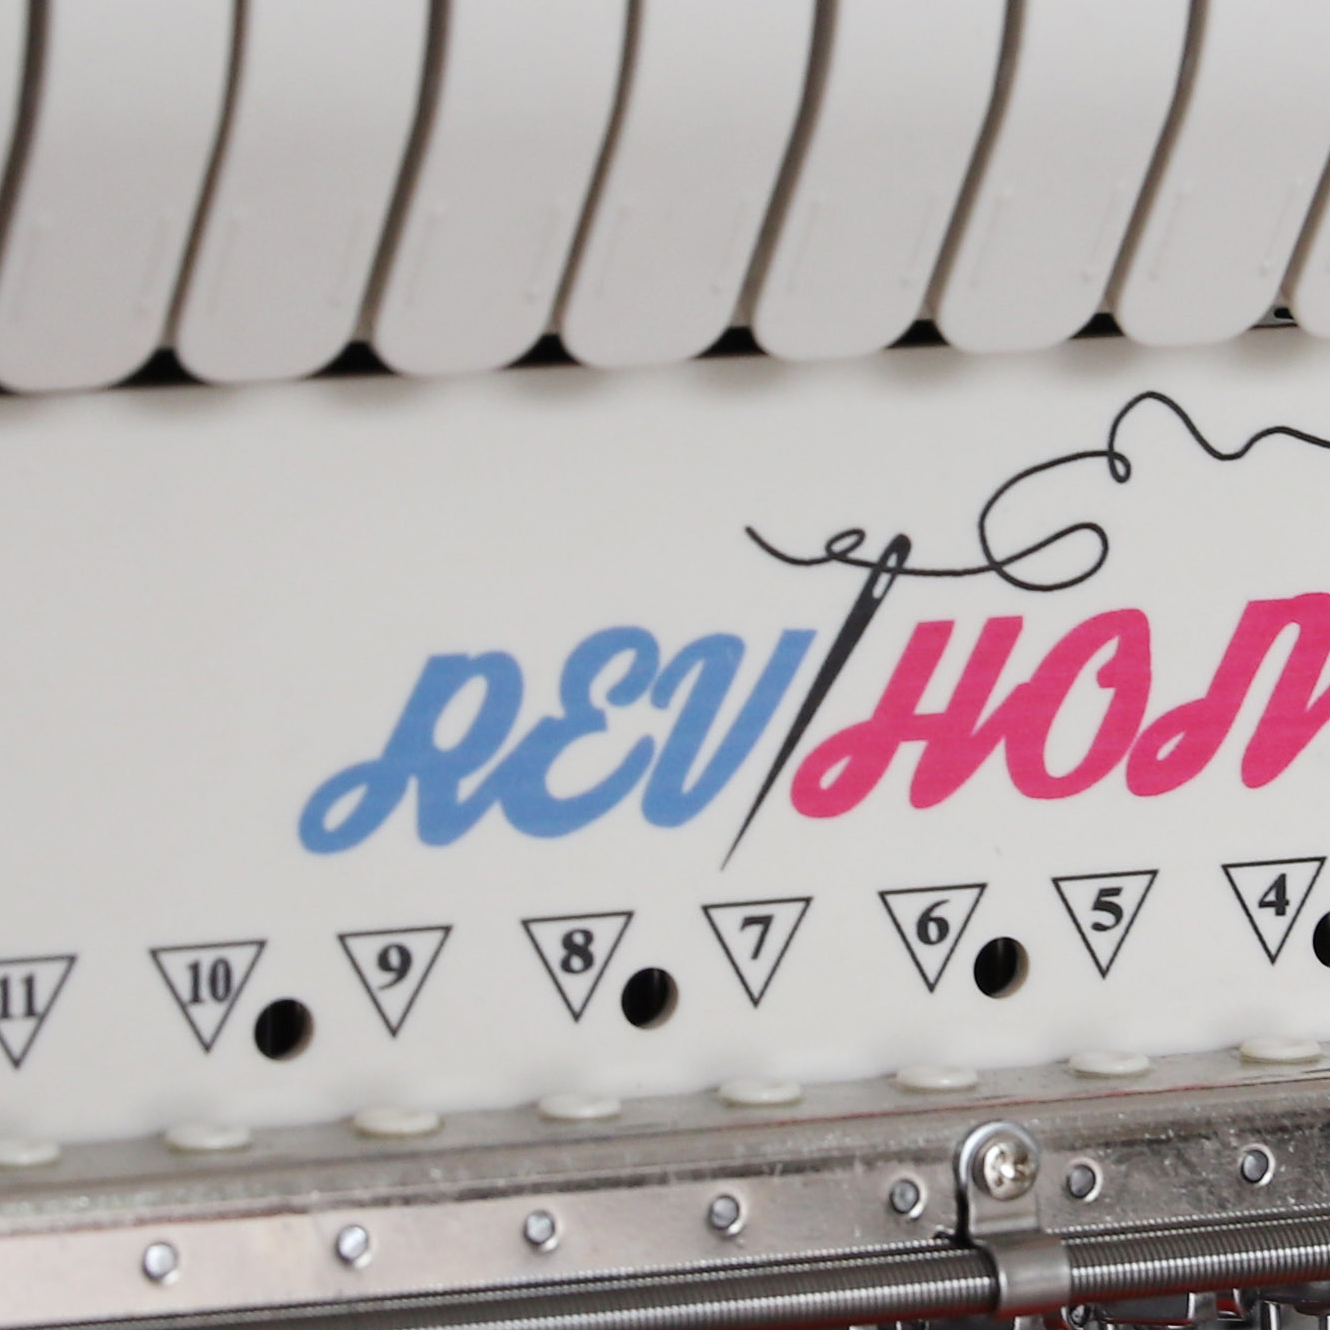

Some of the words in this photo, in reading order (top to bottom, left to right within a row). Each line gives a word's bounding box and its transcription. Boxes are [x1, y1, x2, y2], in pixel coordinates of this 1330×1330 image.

[187, 958, 232, 1005] 10
[377, 944, 412, 988] 9
[560, 929, 594, 975] 8
[741, 914, 773, 960] 7
[916, 900, 950, 946] 6
[1091, 887, 1124, 932] 5
[1258, 873, 1290, 917] 4
